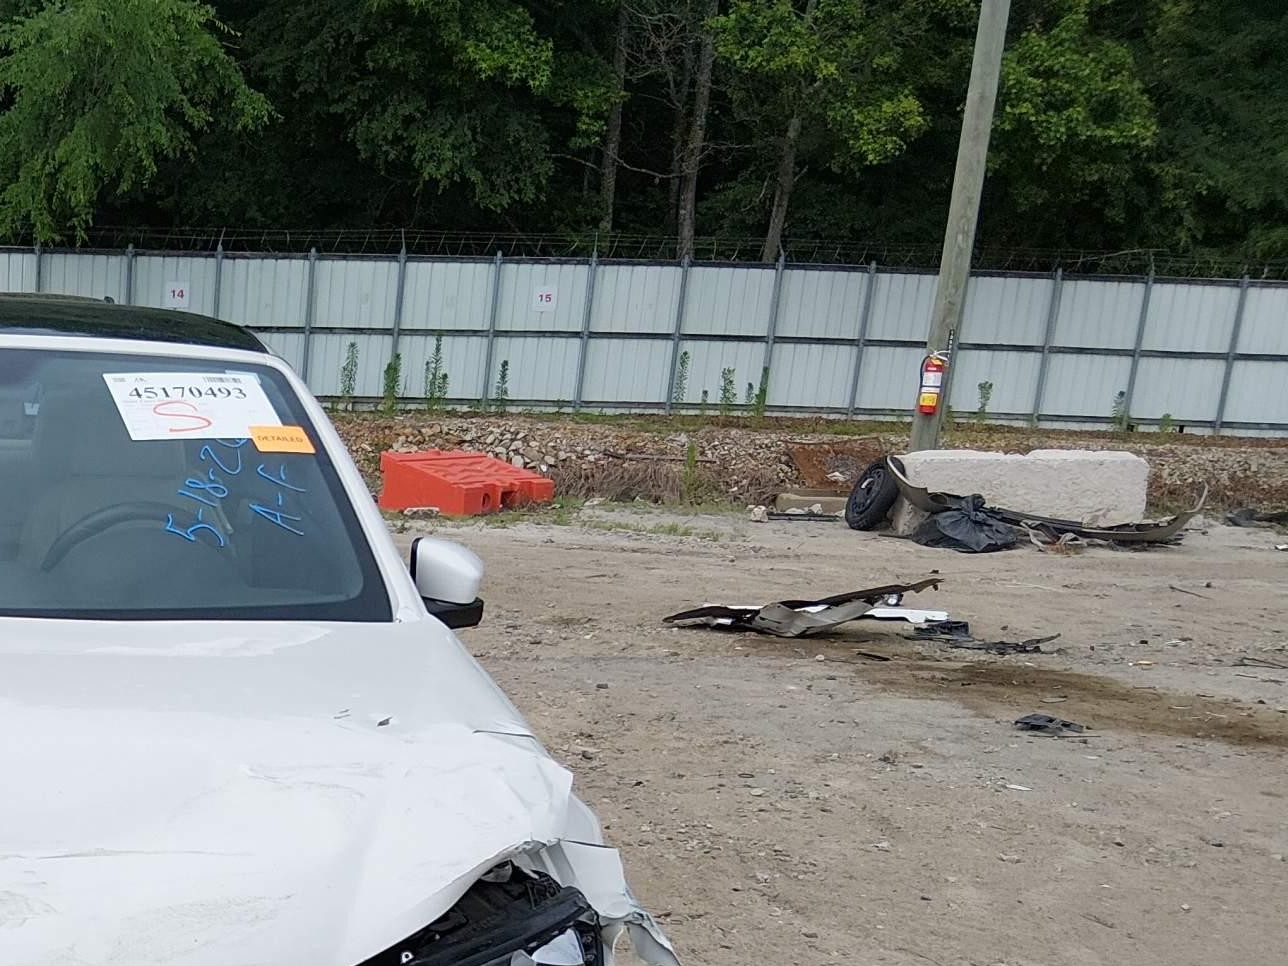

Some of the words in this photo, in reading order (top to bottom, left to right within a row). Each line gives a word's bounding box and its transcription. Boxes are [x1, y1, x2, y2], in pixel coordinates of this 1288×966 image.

[171, 289, 184, 299] 14
[538, 293, 552, 303] 15
[129, 386, 247, 400] 45170493
[153, 400, 213, 433] S
[257, 435, 304, 443] DETAILED
